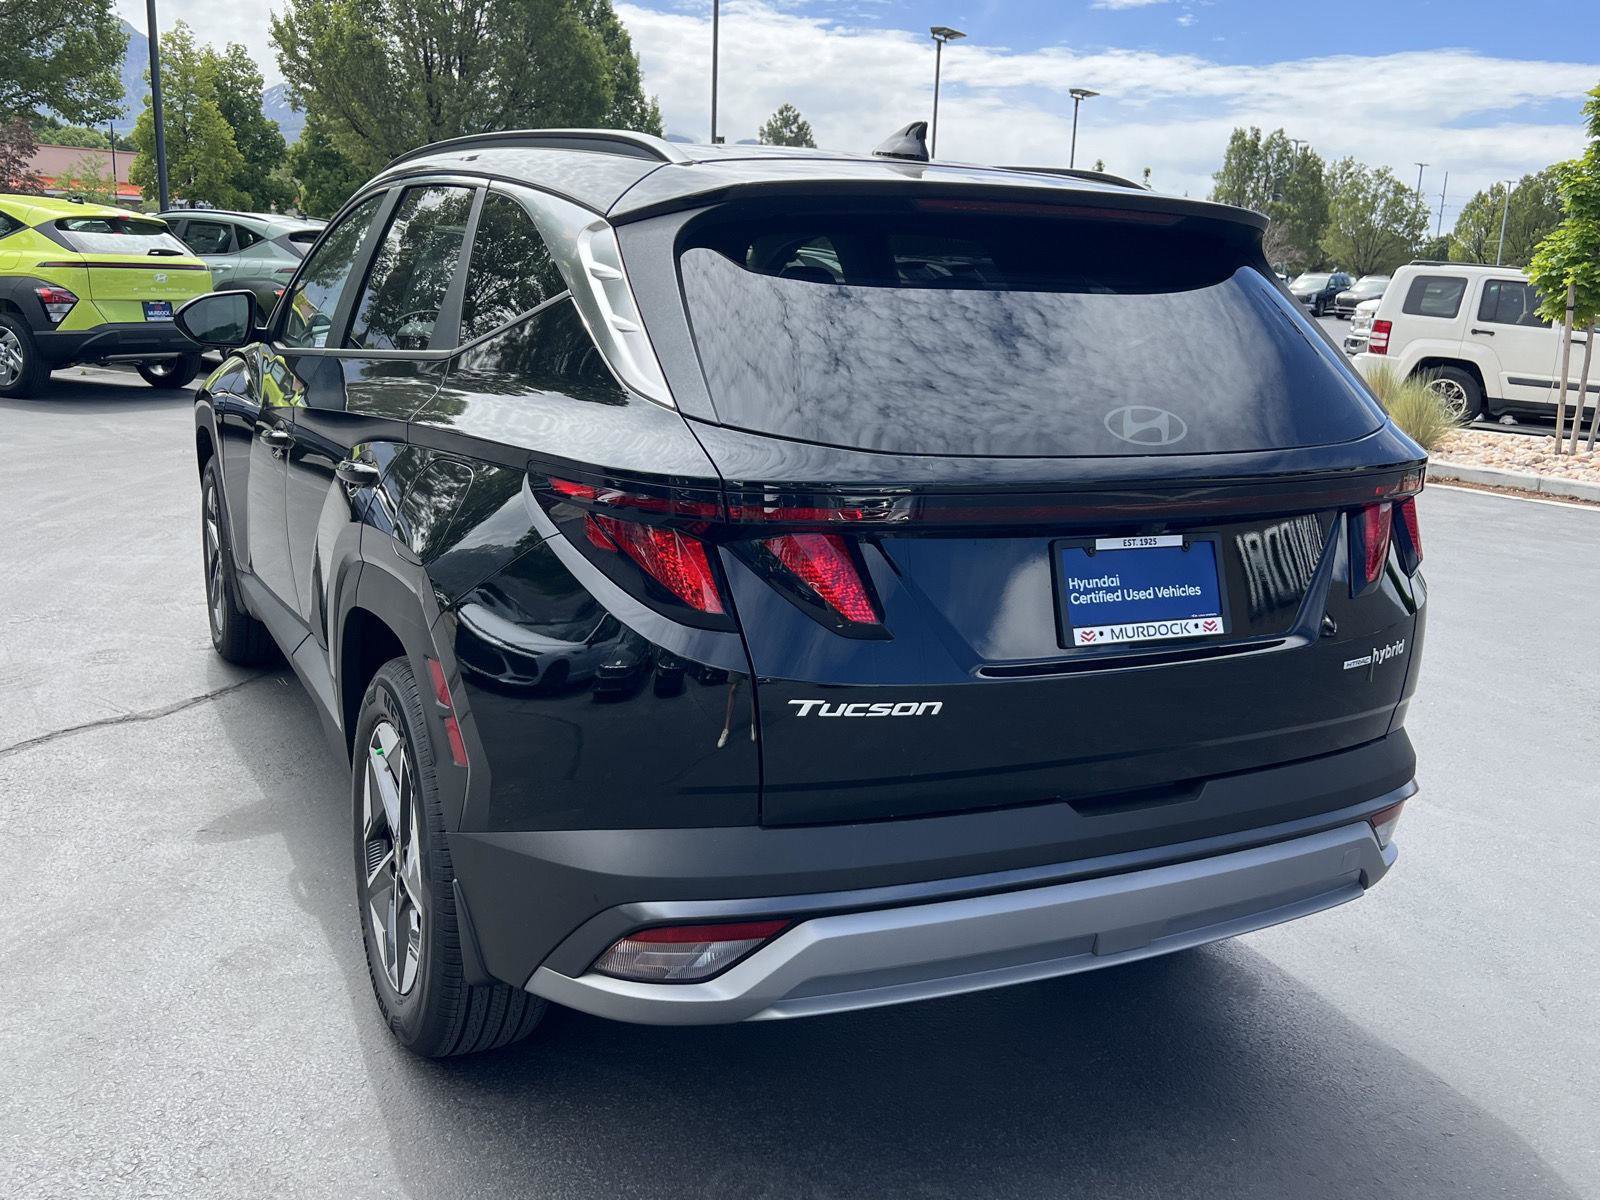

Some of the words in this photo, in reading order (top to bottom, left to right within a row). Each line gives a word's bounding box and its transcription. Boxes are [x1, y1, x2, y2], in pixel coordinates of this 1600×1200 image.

[1123, 538, 1139, 547] EST.
[1139, 537, 1158, 546] 1925
[1068, 574, 1120, 592] Hyundai
[1070, 590, 1123, 605] Certified
[1124, 587, 1154, 601] Used
[1155, 584, 1202, 598] Vehicles
[1110, 621, 1191, 640] MURDOCK
[1372, 639, 1405, 665] hybrid
